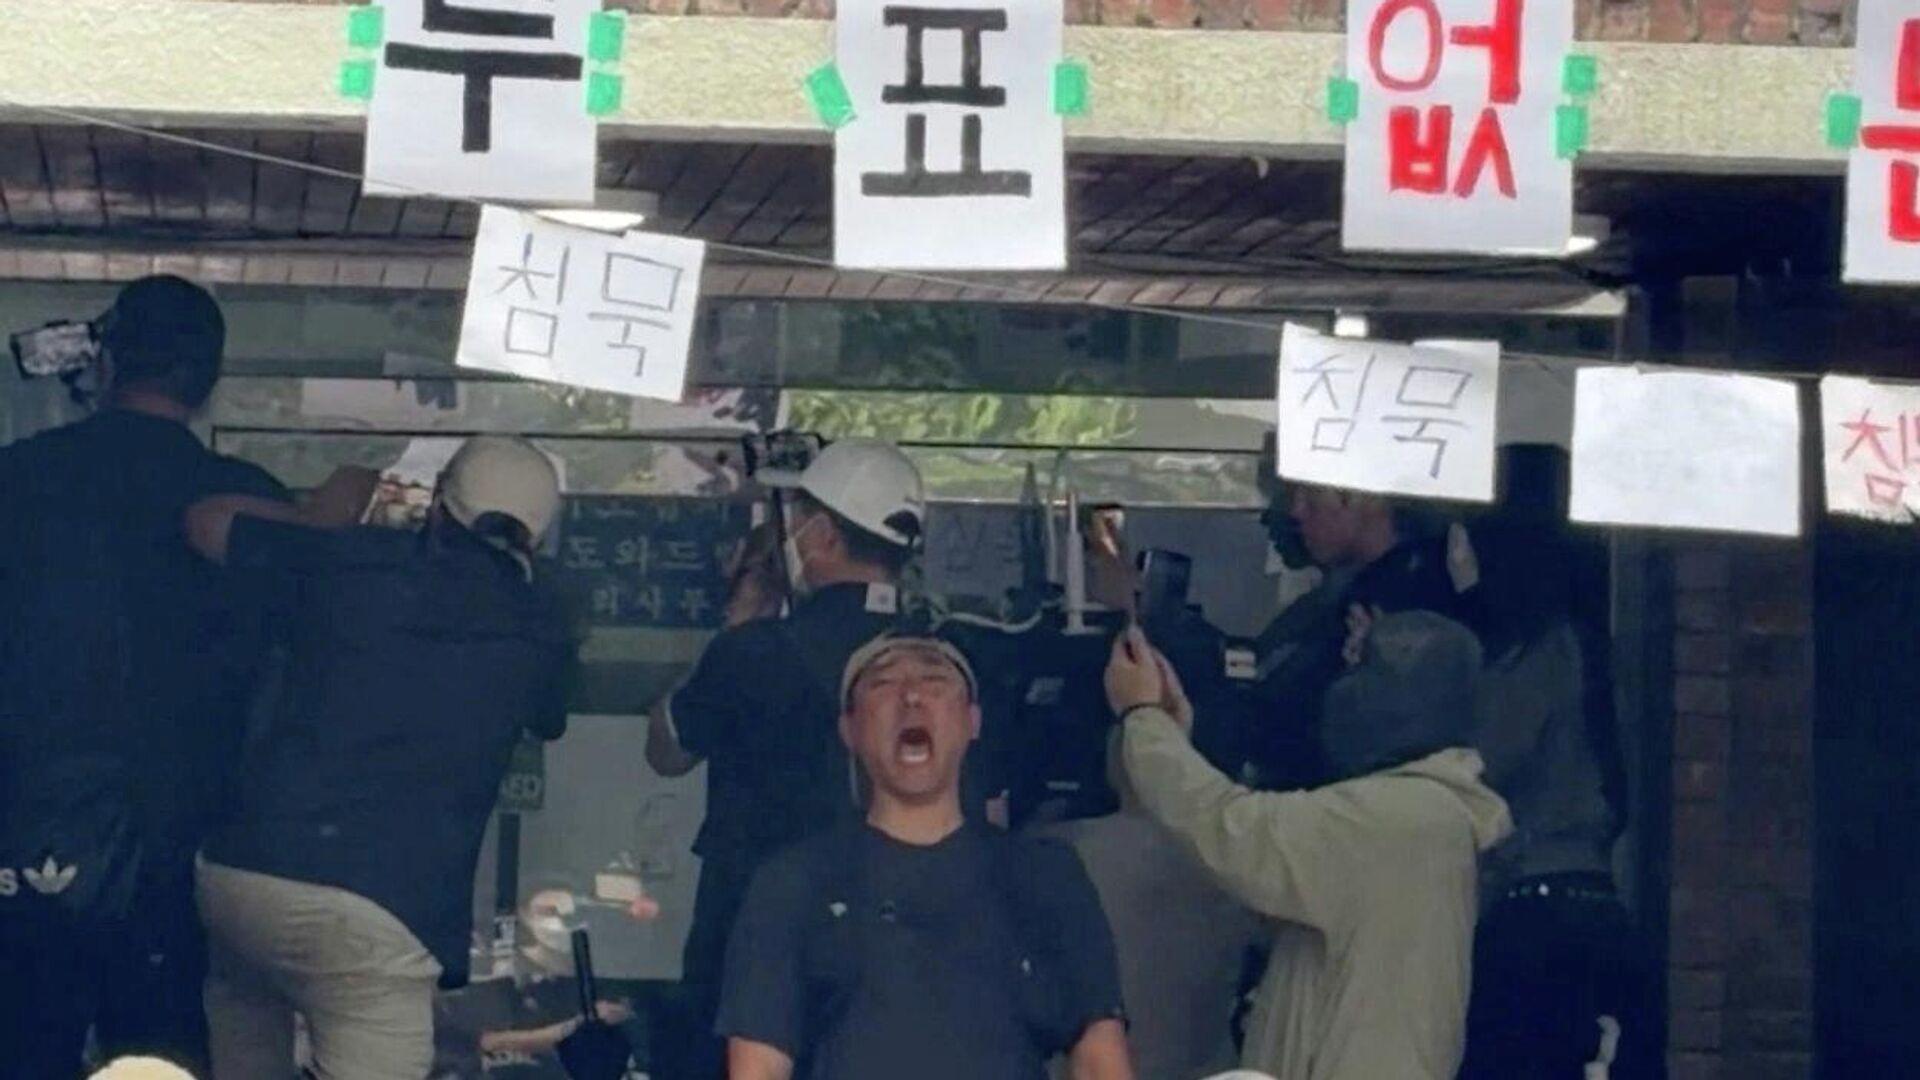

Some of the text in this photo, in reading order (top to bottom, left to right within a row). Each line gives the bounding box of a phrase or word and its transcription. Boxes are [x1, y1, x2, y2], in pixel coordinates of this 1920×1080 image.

[861, 5, 1032, 198] 표
[1368, 0, 1524, 199] 없
[493, 233, 683, 378] 침묵
[1292, 353, 1474, 478] 침묵
[1839, 407, 1920, 507] 침
